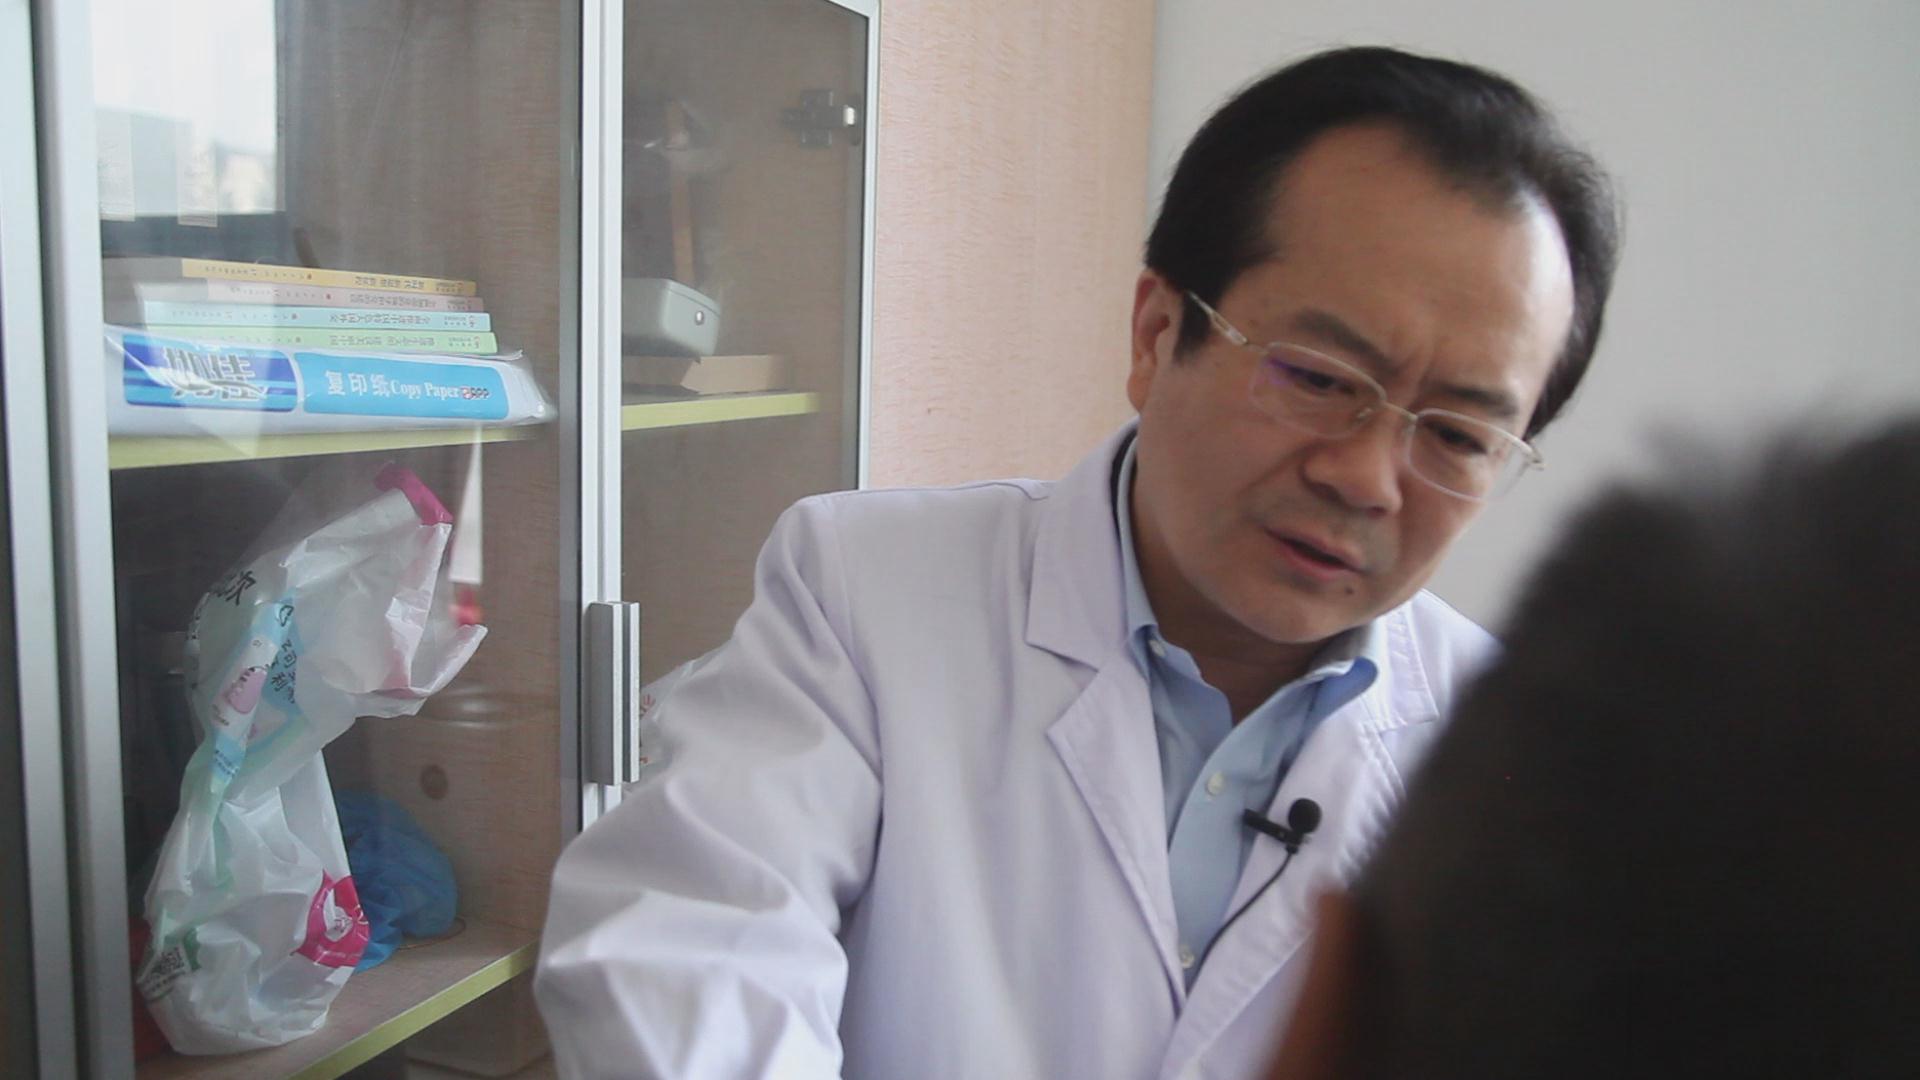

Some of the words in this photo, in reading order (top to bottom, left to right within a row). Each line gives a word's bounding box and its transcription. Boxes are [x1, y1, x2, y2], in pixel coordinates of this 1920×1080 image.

[325, 370, 390, 397] 复印纸
[390, 380, 422, 399] Copy
[424, 382, 460, 400] Paper
